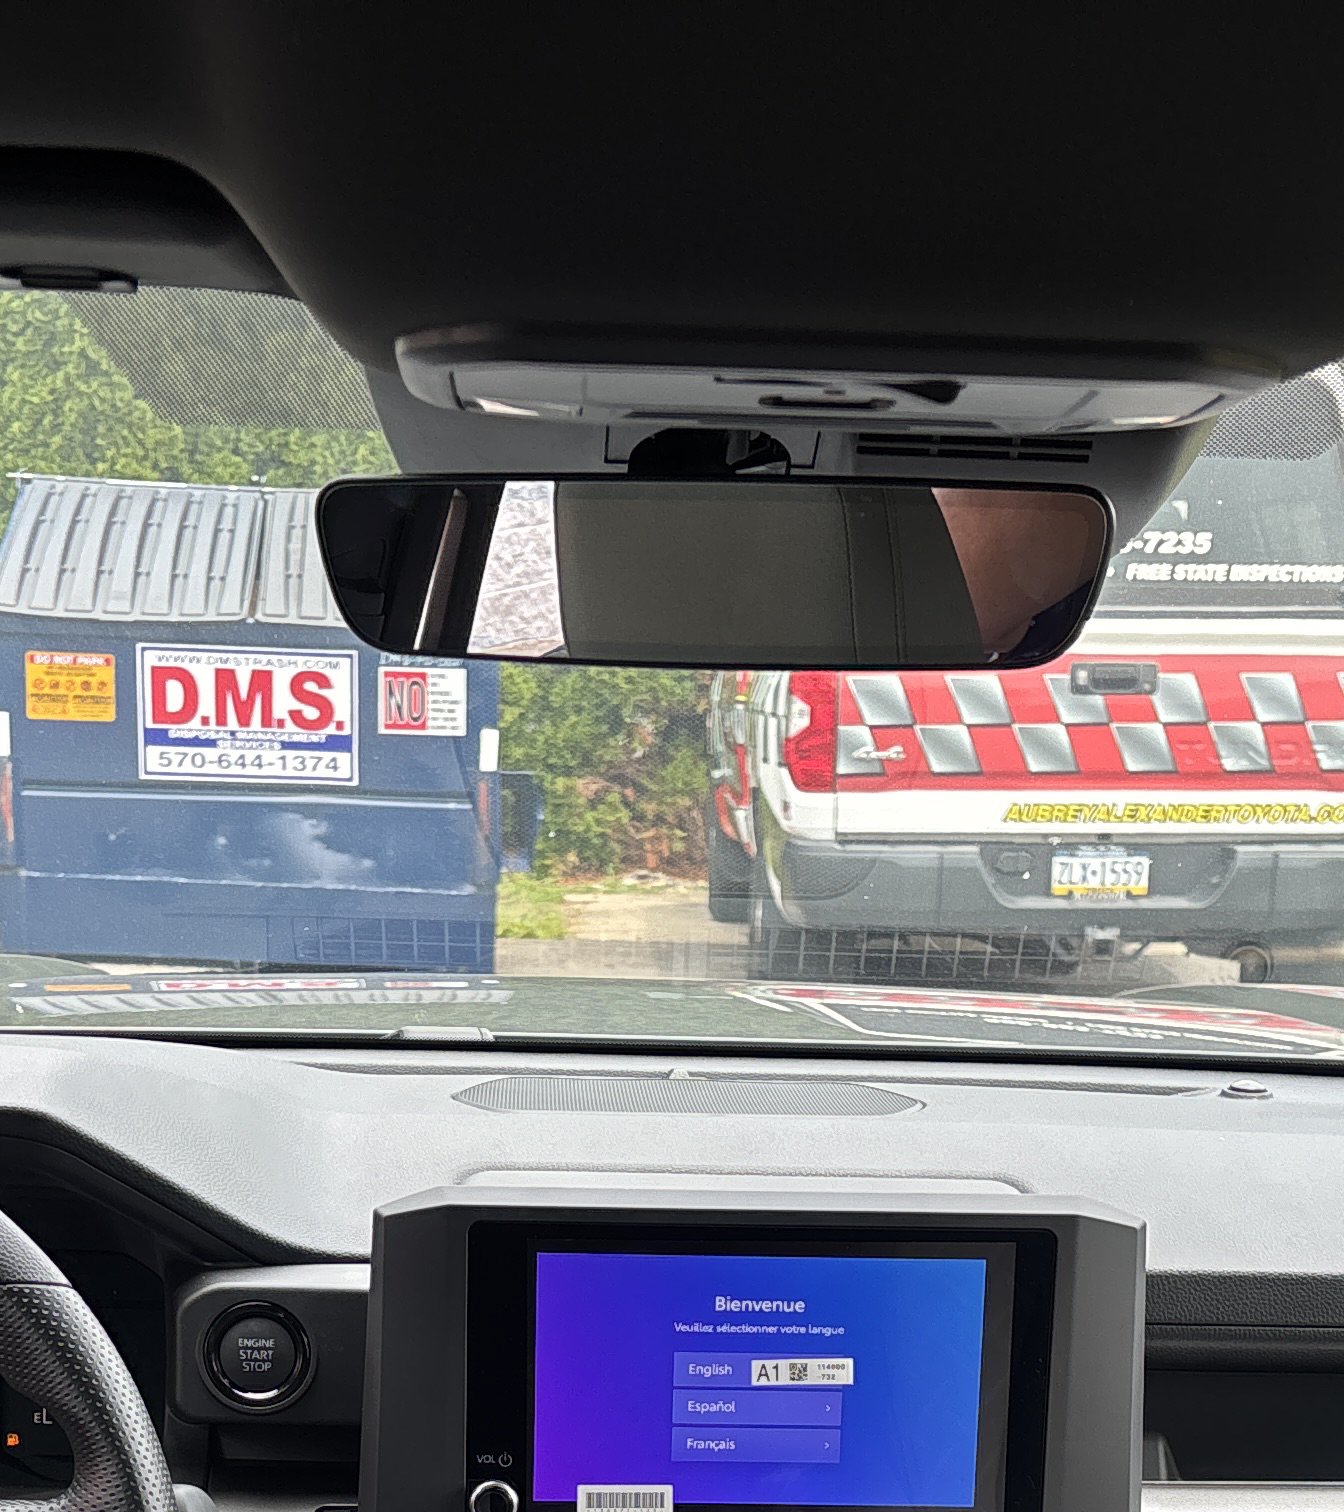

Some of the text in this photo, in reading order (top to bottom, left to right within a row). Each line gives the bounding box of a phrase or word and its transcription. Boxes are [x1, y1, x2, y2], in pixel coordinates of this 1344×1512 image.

[1125, 562, 1344, 583] FREE STATE INSPECTIONS
[150, 665, 345, 731] D.M.S.
[386, 677, 426, 725] NO
[158, 752, 341, 772] 570-644-1374
[714, 1295, 806, 1313] Bienvenue
[674, 1322, 845, 1337] Veuillez sélectionner votre langue
[238, 1337, 276, 1349] ENGINE
[239, 1349, 274, 1361] START
[242, 1361, 272, 1372] STOP
[688, 1363, 733, 1378] English
[756, 1362, 780, 1383] A1
[687, 1400, 736, 1414] Español
[686, 1437, 736, 1452] Français
[476, 1454, 496, 1464] VOL
